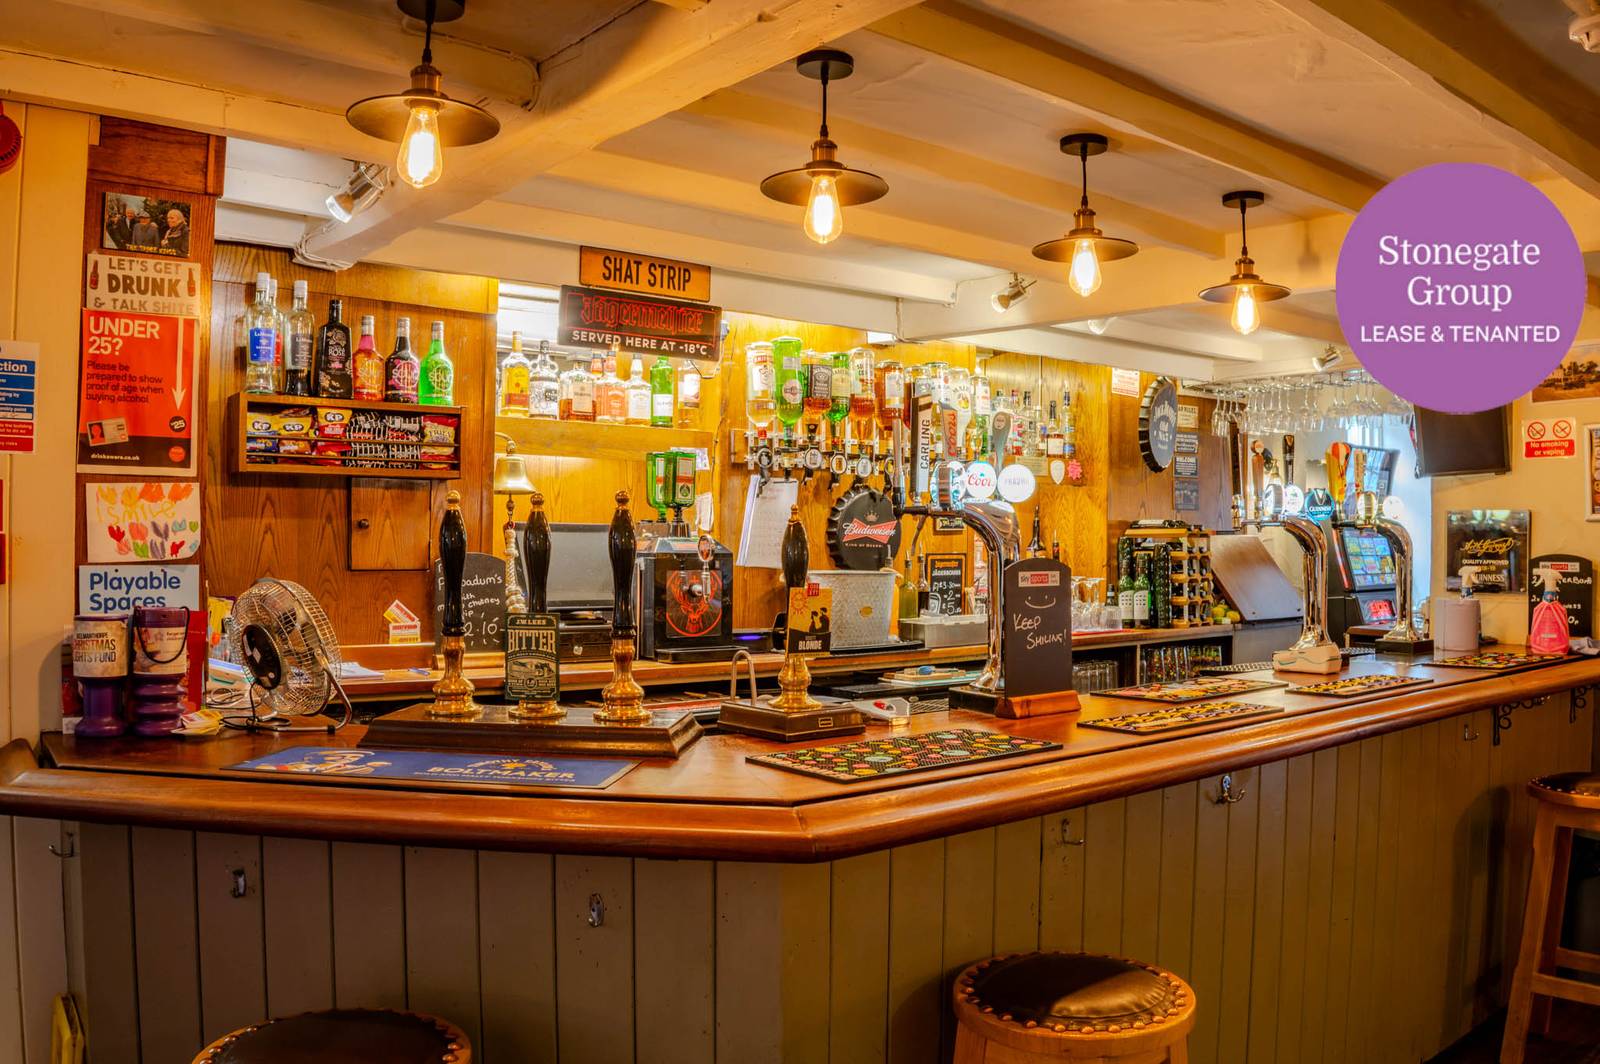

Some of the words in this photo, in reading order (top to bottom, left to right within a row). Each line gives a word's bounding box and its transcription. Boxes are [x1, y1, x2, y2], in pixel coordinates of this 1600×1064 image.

[108, 257, 148, 273] LET'S
[153, 261, 181, 275] GET
[602, 255, 643, 286] SHAT
[647, 262, 692, 292] STRIP
[107, 273, 182, 298] DRUNK
[94, 297, 106, 308] &
[111, 298, 148, 312] TALK
[152, 301, 194, 316] SHITE
[89, 316, 161, 340] UNDER
[87, 336, 124, 356] 25?
[572, 330, 622, 345] SERVED
[625, 336, 658, 349] HERE
[660, 341, 677, 351] AT
[679, 343, 708, 355] -18°C
[87, 360, 117, 371] Please
[119, 362, 130, 372] be
[86, 371, 127, 382] prepared
[128, 374, 137, 382] to
[139, 374, 164, 384] show
[86, 383, 109, 392] proof
[111, 383, 120, 391] of
[121, 385, 138, 394] age
[139, 385, 164, 394] when
[86, 394, 115, 403] buying
[325, 412, 344, 422] KP
[253, 421, 271, 430] KP
[284, 423, 304, 432] KP
[920, 419, 931, 470] CARLING
[1541, 440, 1569, 449] smoking
[91, 453, 140, 461] drinkaware.co.uk
[1543, 449, 1565, 457] vaping
[843, 522, 896, 537] Budweiser
[89, 571, 181, 594] Playable
[1475, 573, 1505, 582] UINNESS
[89, 593, 166, 614] Spaces
[468, 598, 500, 608] chutney
[1013, 613, 1042, 633] KEEP
[507, 629, 556, 654] BITTER
[799, 640, 822, 650] BLONDE
[94, 651, 117, 663] FUND
[426, 767, 575, 779] BOLTMAKER
